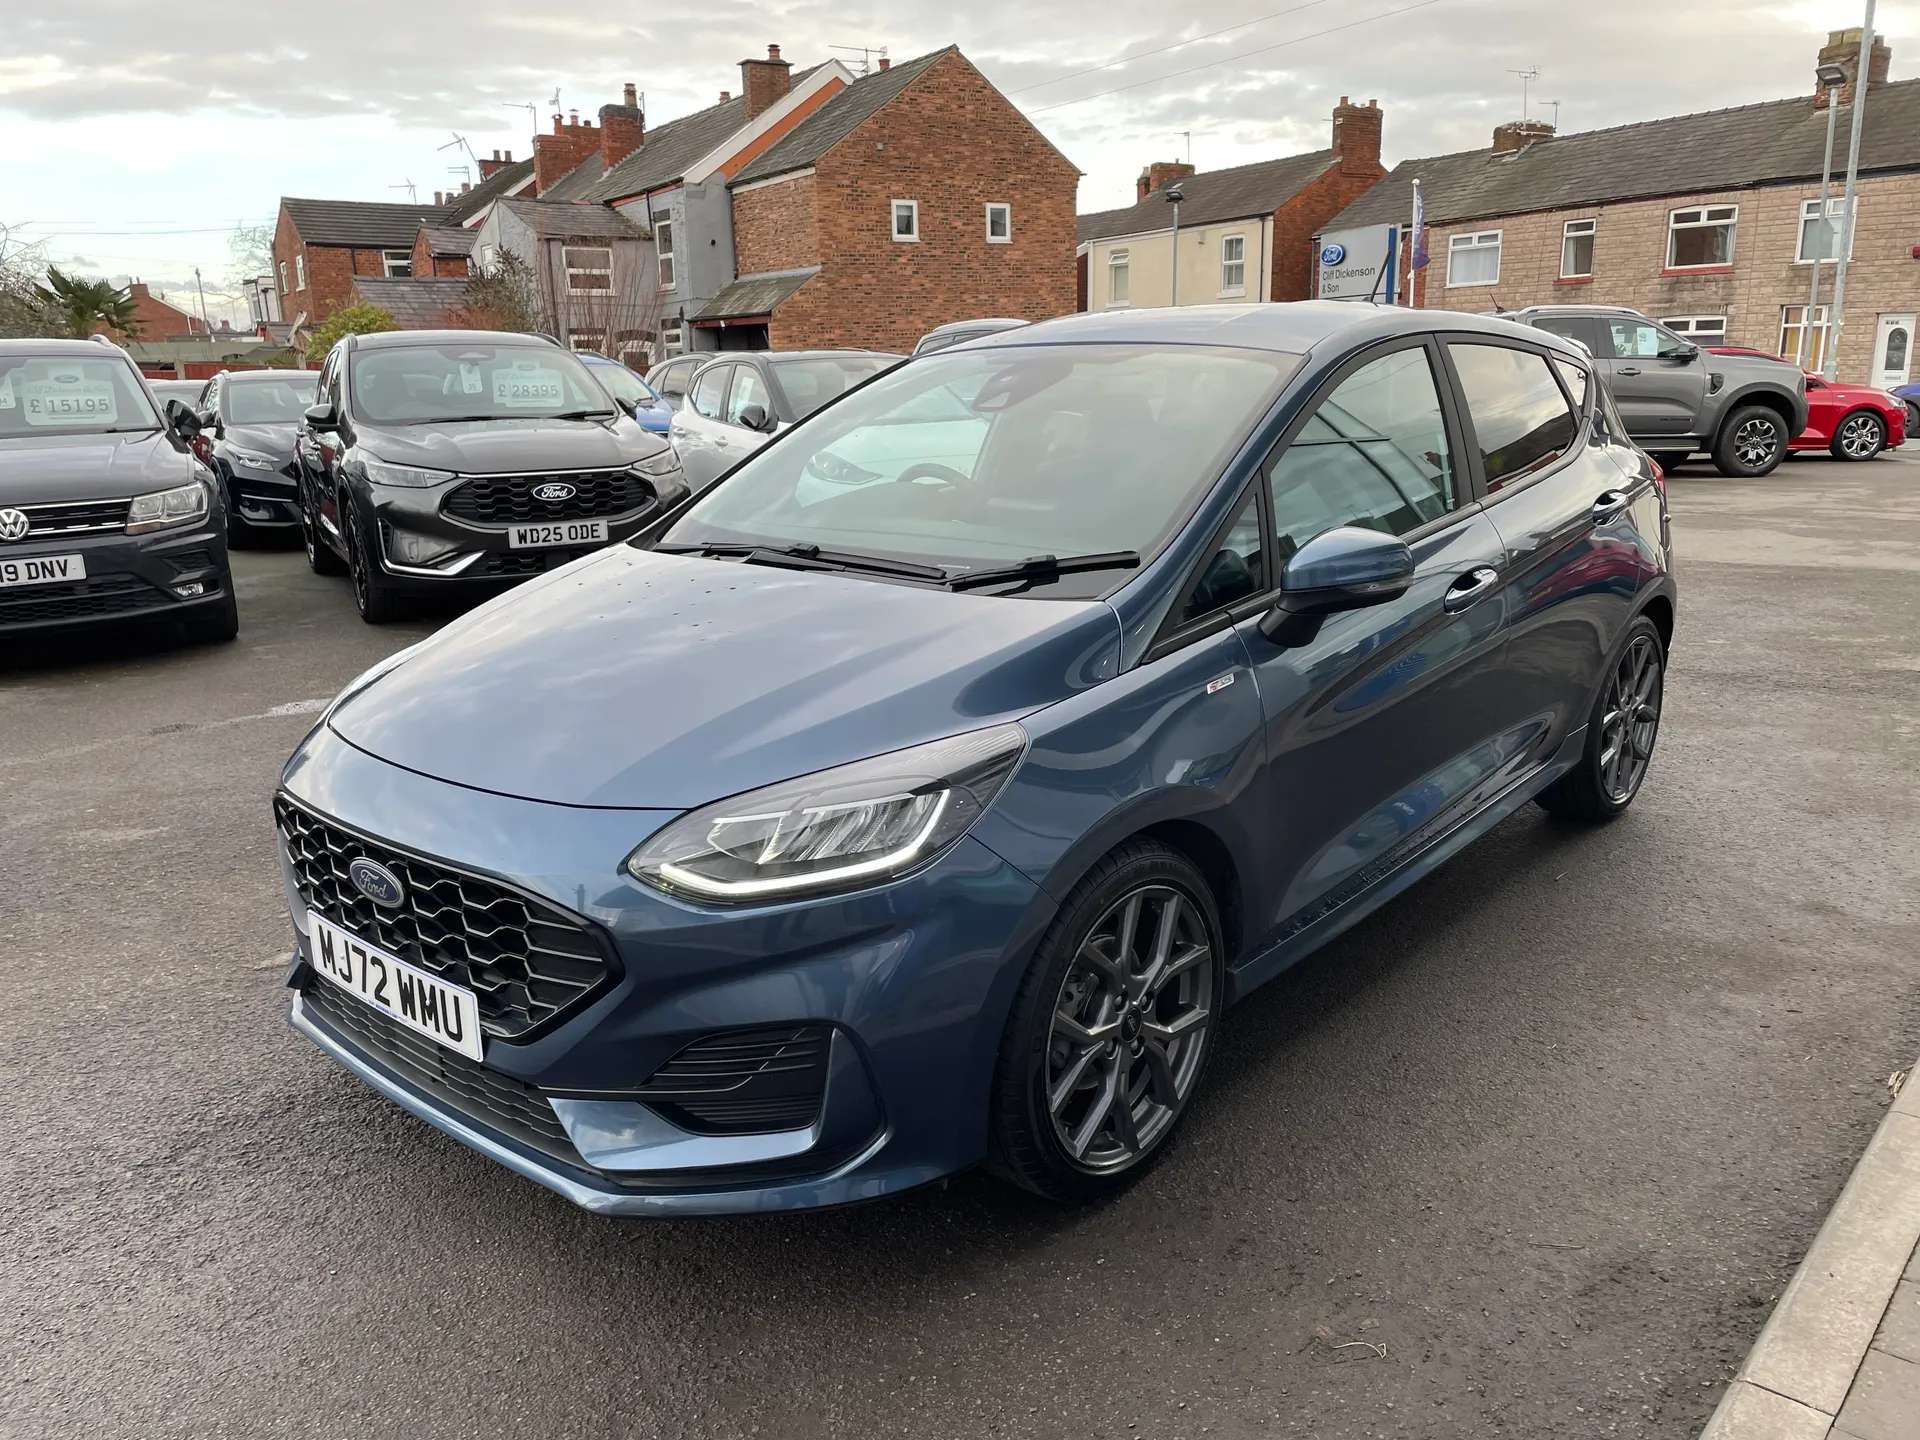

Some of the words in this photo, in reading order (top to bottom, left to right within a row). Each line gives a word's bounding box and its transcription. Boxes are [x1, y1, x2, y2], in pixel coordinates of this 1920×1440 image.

[1335, 267, 1376, 279] Dickenson
[1327, 283, 1340, 293] Son
[517, 526, 564, 545] WD25
[568, 523, 601, 541] ODE
[24, 559, 68, 580] DNV
[360, 869, 389, 899] Ford
[318, 923, 391, 1008] MJ72
[396, 967, 464, 1043] WMU
